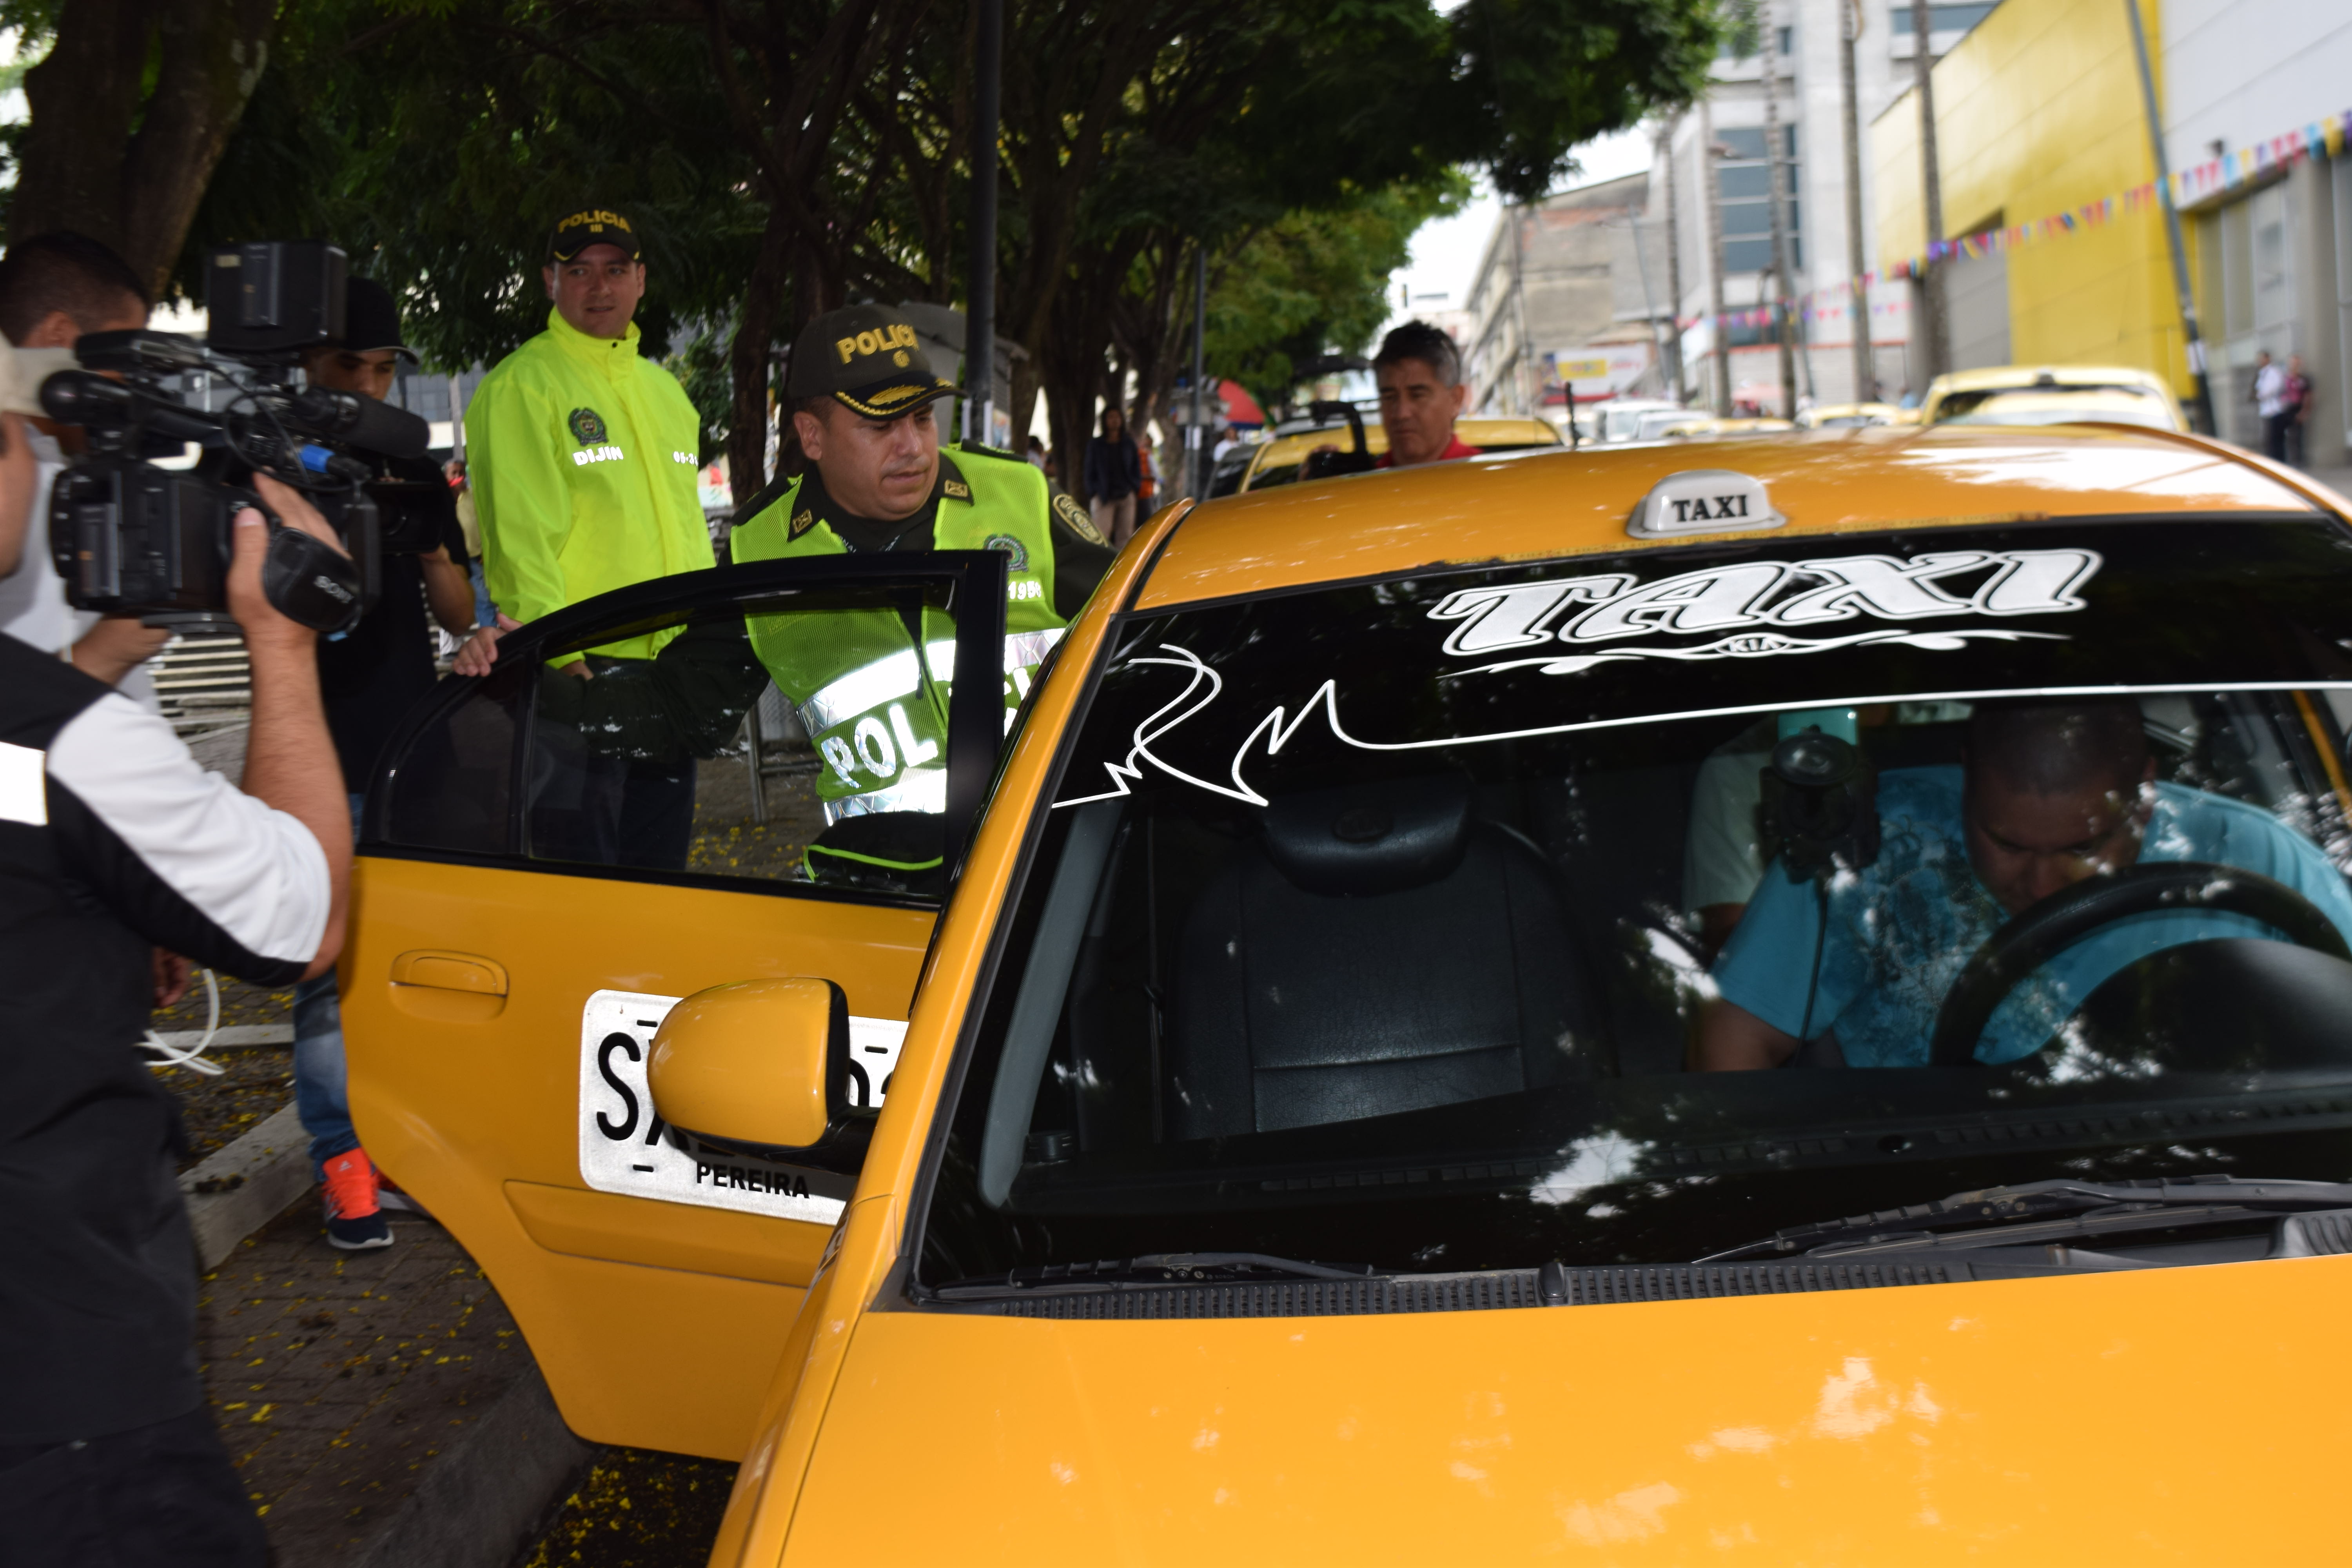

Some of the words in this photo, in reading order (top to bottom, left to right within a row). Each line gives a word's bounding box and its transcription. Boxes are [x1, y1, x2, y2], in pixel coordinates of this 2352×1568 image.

[558, 209, 632, 233] POLICIA
[835, 325, 920, 365] POLICI
[573, 446, 624, 466] DIJIN
[1672, 495, 1748, 522] TAXI
[1426, 548, 2104, 656] TAXI
[1728, 638, 1782, 652] KIA
[697, 1161, 810, 1199] PEREIRA
